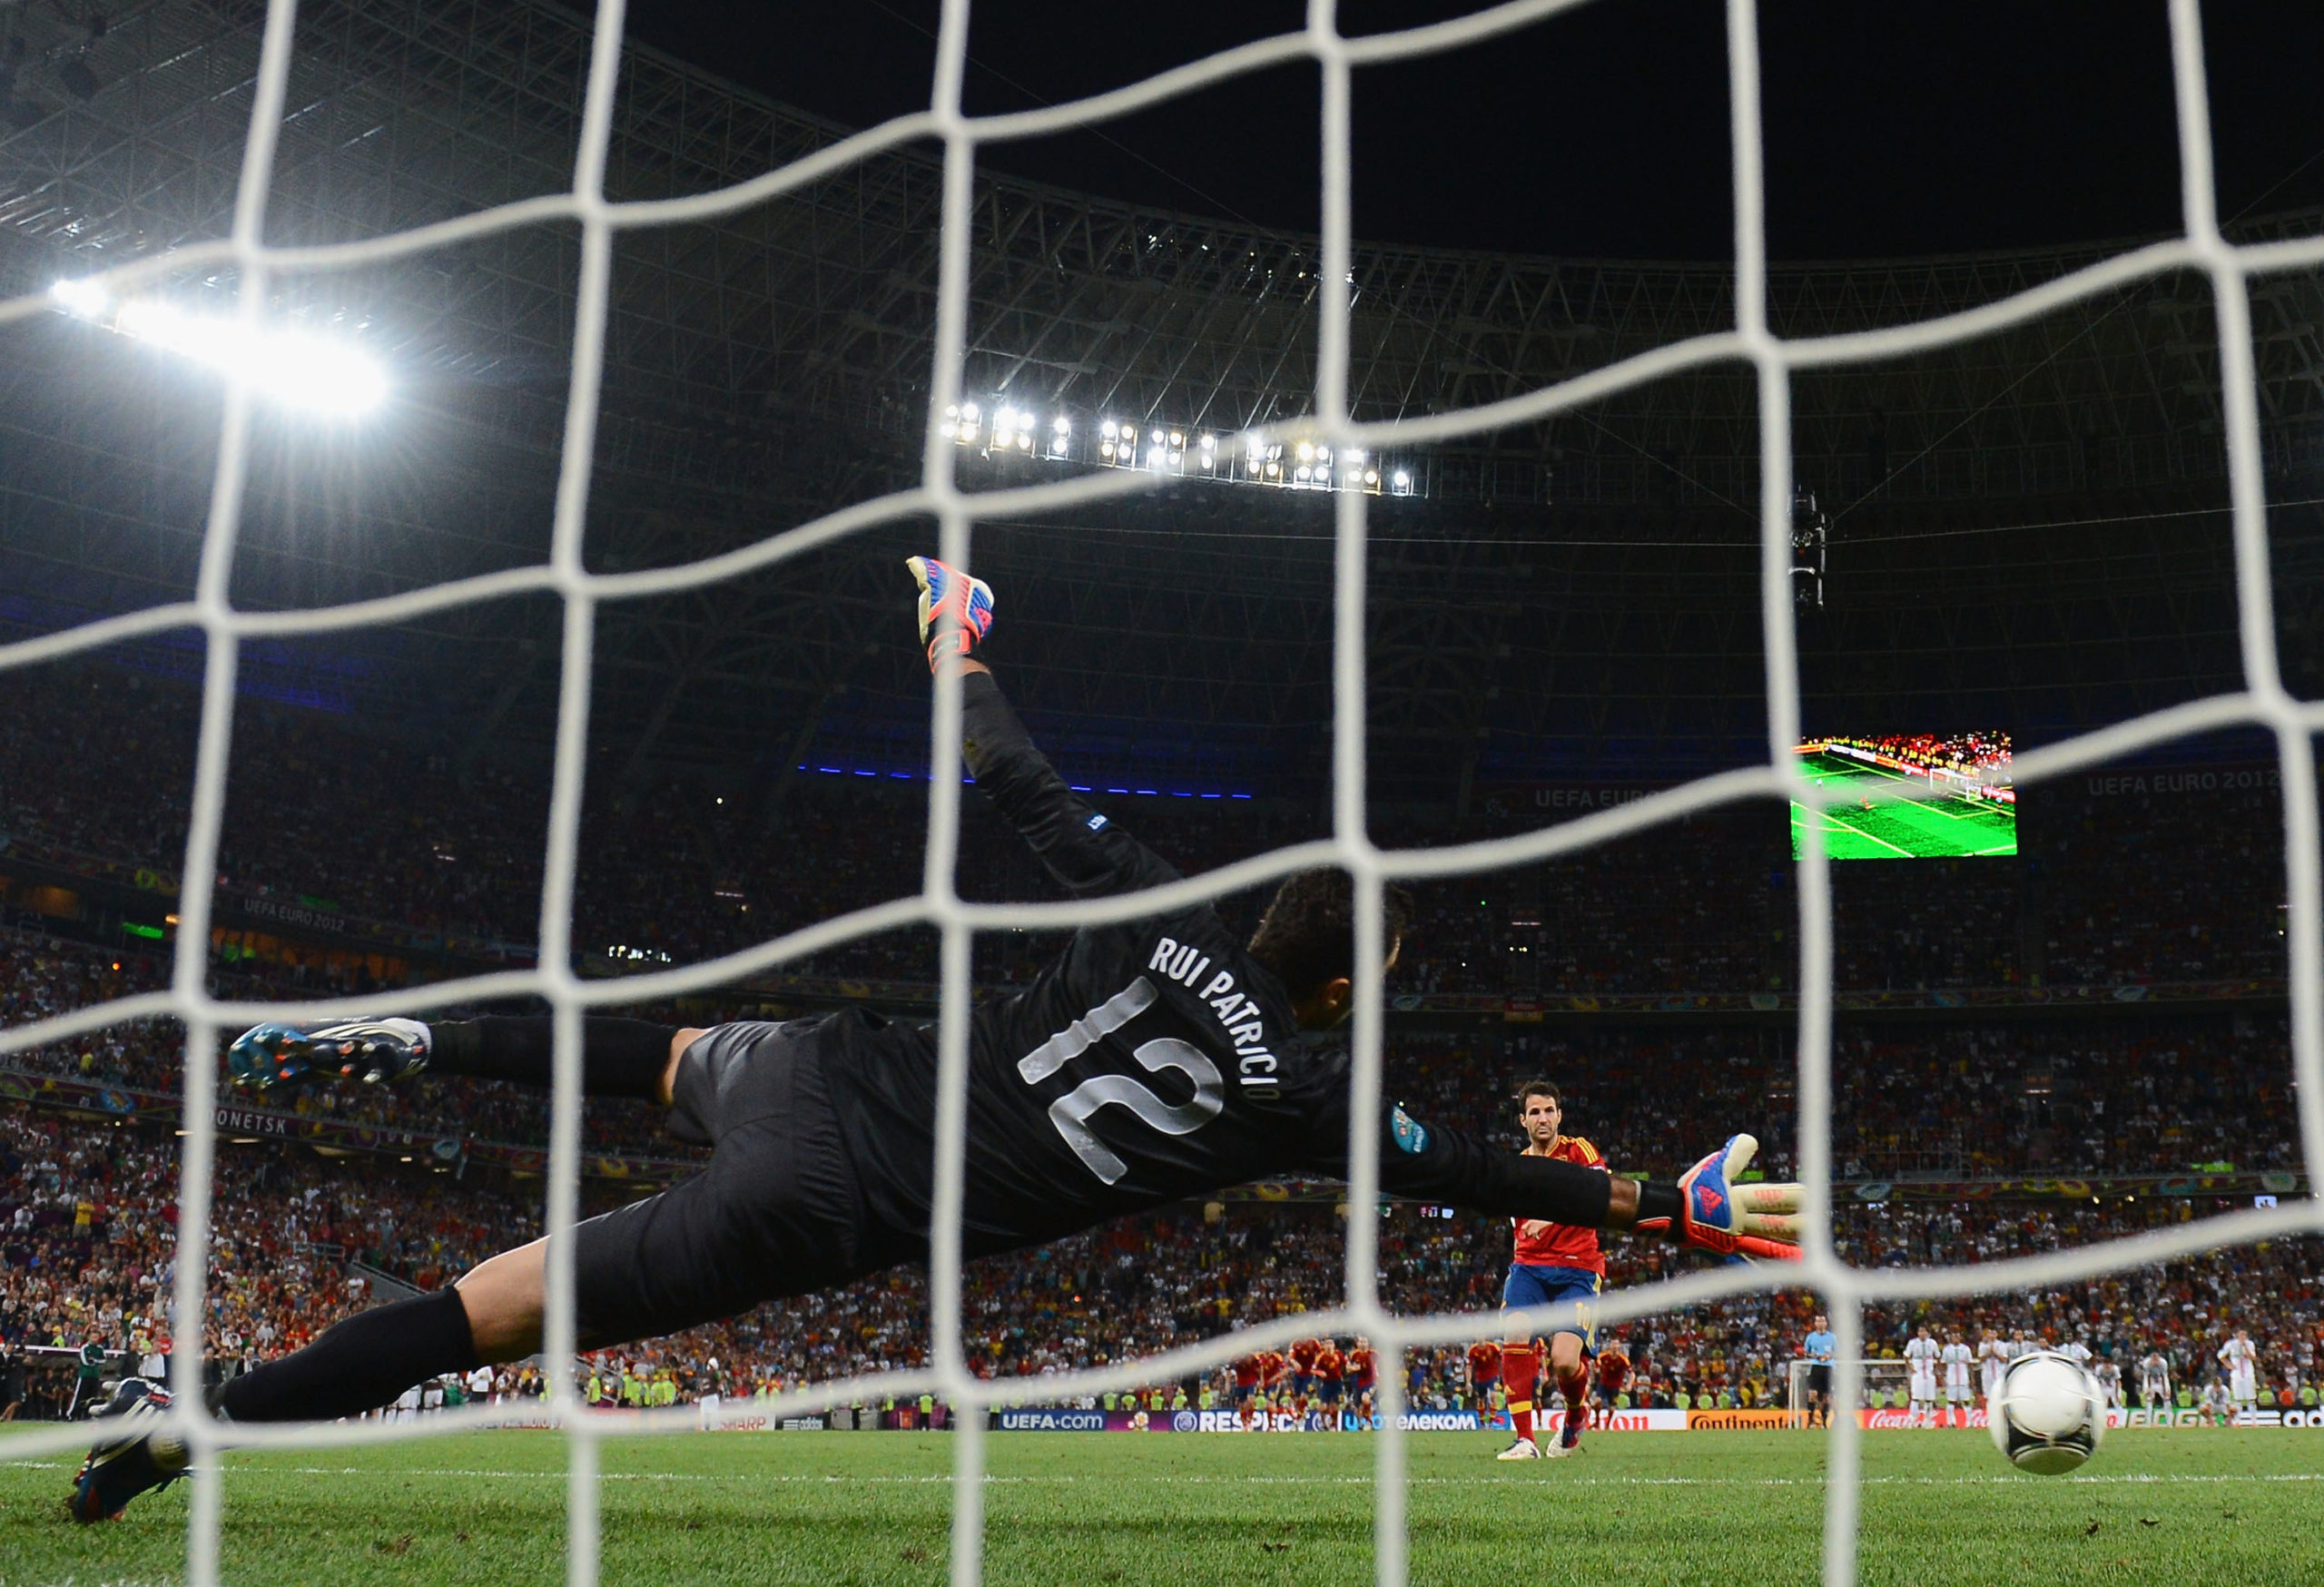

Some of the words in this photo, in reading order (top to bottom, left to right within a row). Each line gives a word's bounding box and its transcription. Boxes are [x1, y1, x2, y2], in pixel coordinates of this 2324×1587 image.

[2089, 776, 2148, 796] UEFA
[2153, 773, 2217, 793] EURO
[2222, 770, 2280, 788] 2012
[1536, 789, 1594, 807] UEFA
[243, 897, 277, 917] UEFA
[278, 905, 313, 926] EURO
[313, 913, 346, 932] 2012
[1148, 937, 1210, 988] RUI
[1198, 971, 1281, 1100] PATRICIO
[1017, 975, 1225, 1186] 12
[211, 1109, 287, 1135] ONETSK
[719, 1414, 767, 1432] SHARP
